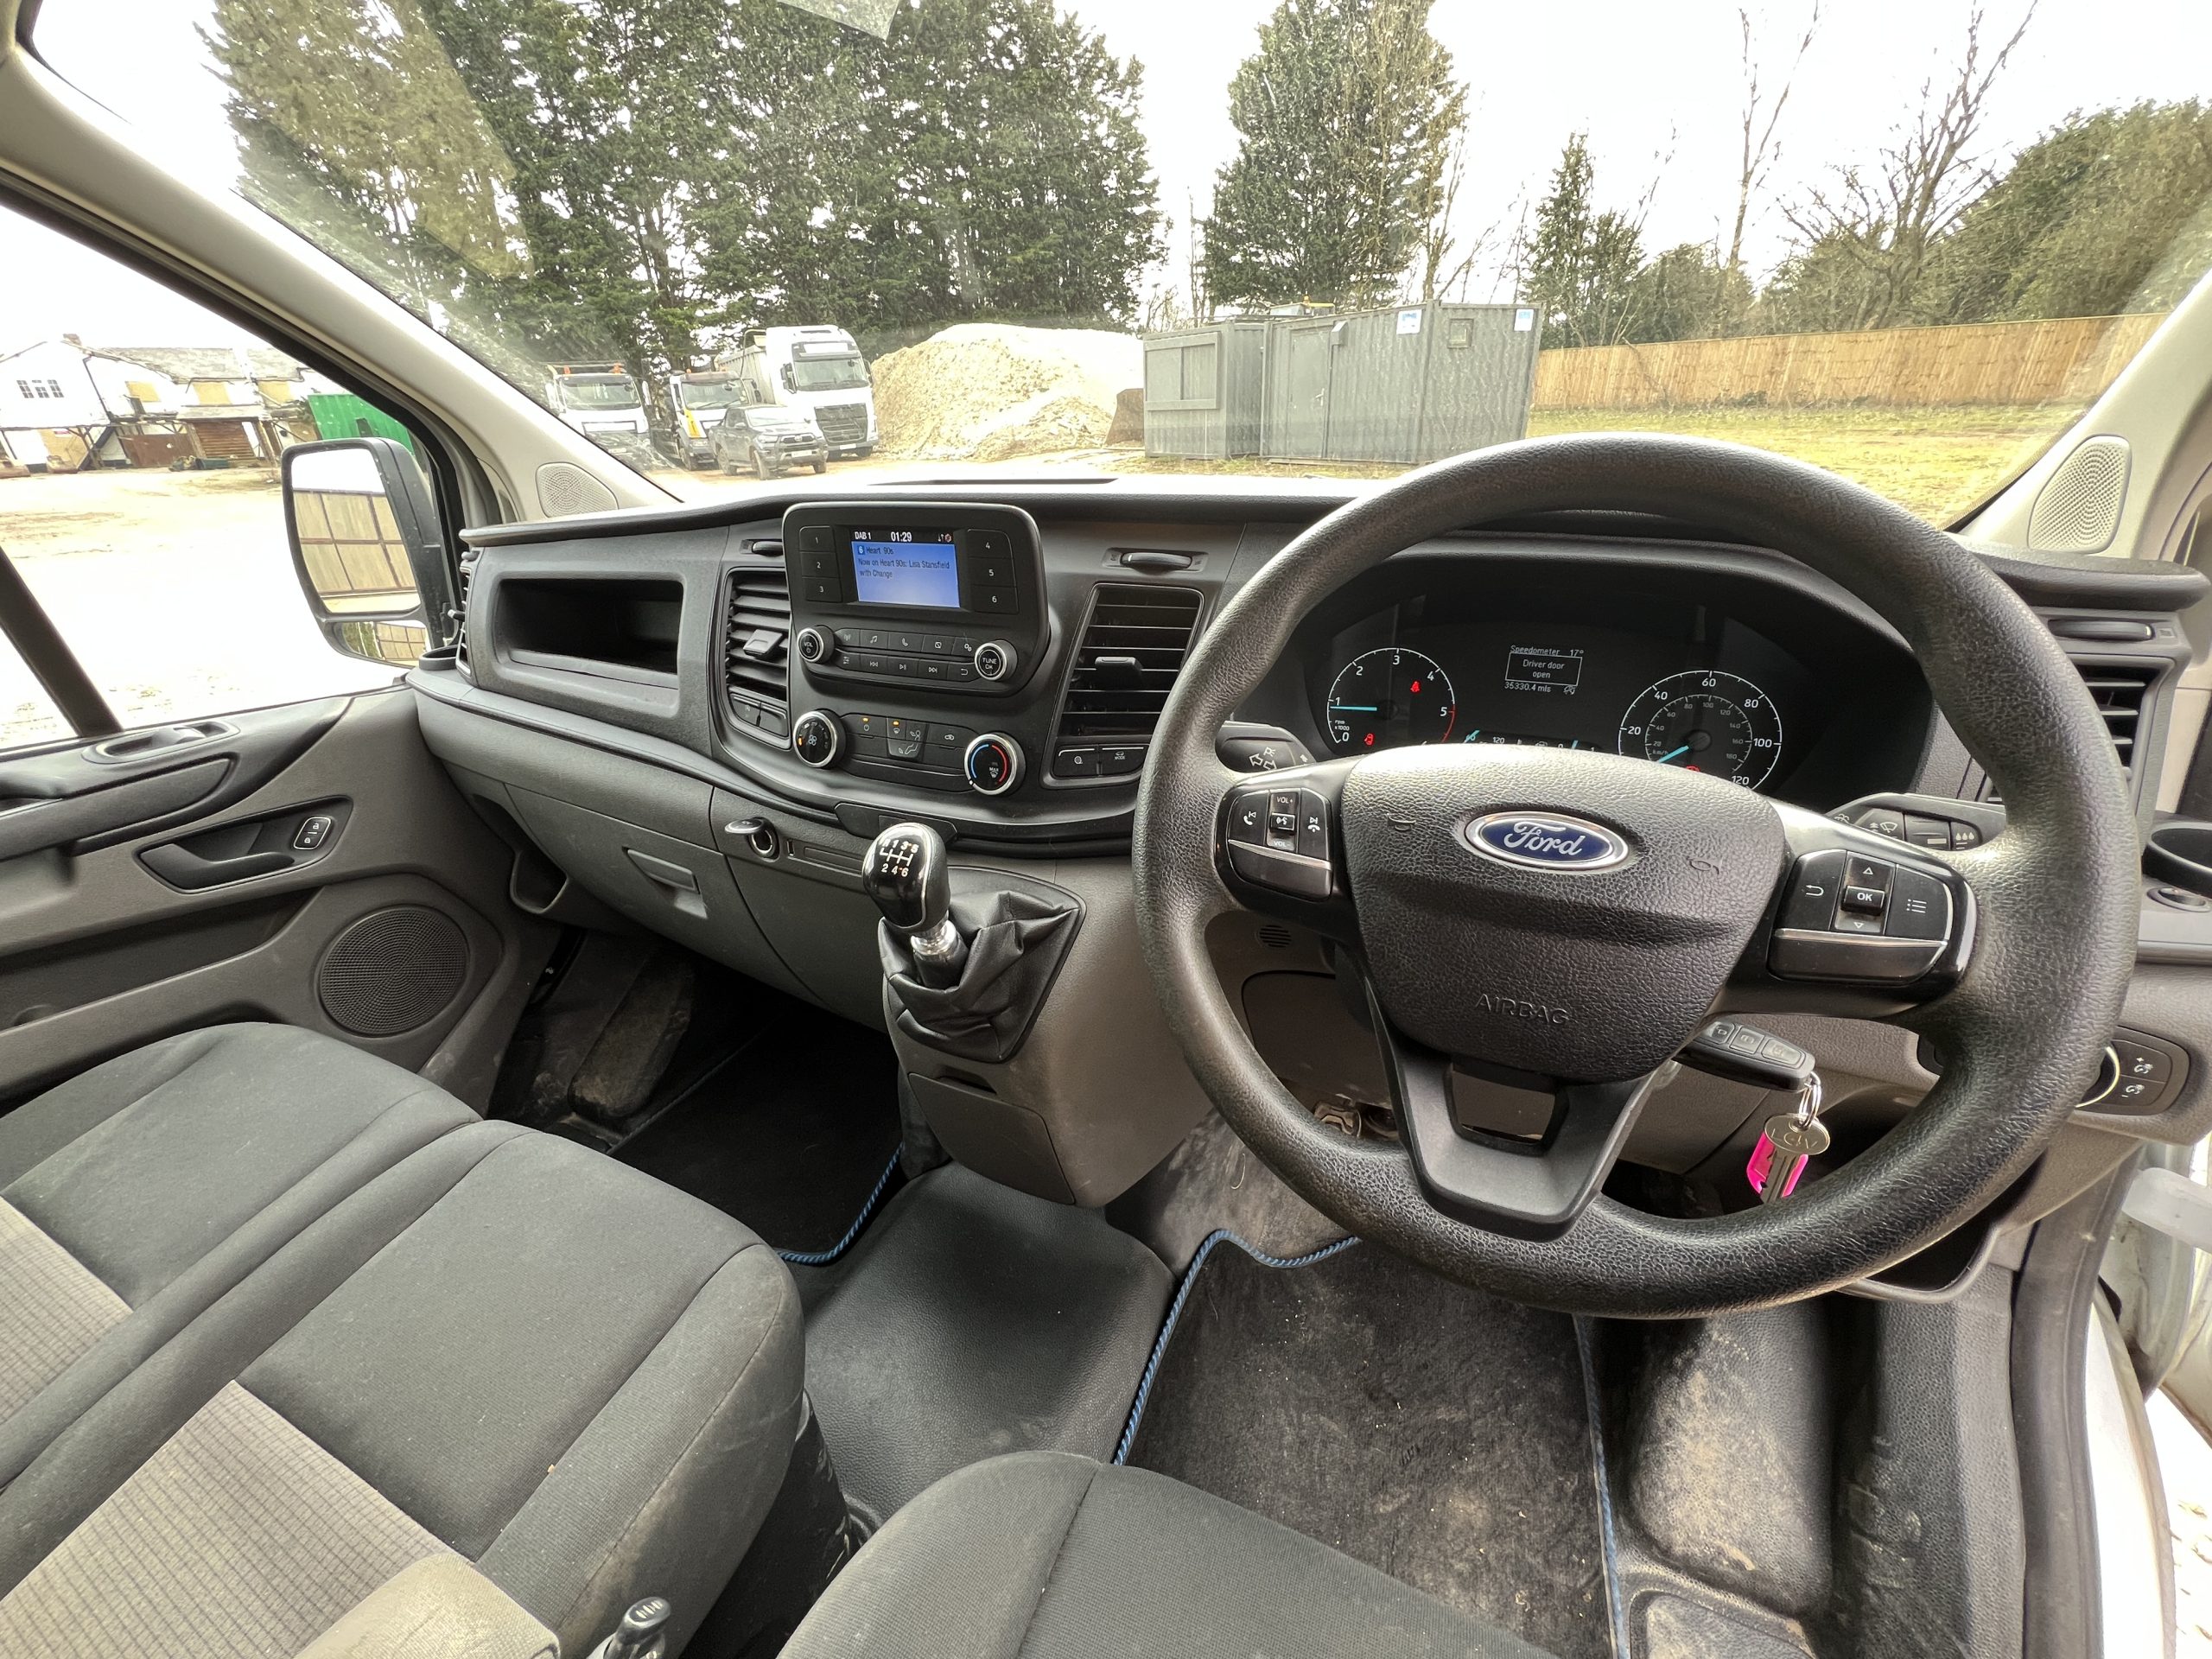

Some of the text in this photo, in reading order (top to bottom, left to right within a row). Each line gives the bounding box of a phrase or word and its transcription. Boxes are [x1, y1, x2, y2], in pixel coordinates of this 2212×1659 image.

[855, 531, 872, 540] DAB 1
[890, 531, 912, 542] 01:29
[922, 561, 950, 569] Stansfield
[873, 570, 893, 579] Change
[1510, 645, 1560, 656] Speedometer
[1392, 655, 1400, 664] 3
[1522, 659, 1565, 670] Driver door
[1356, 666, 1363, 676] 2
[1427, 671, 1434, 681] 4
[1504, 682, 1535, 691] 35330.4
[1701, 678, 1716, 687] 60
[1654, 691, 1668, 701] 40
[1335, 696, 1340, 706] 1
[1744, 699, 1758, 708] 80
[1440, 707, 1447, 716] 5
[1627, 726, 1642, 735] 20
[1342, 732, 1350, 741] 0
[1753, 738, 1772, 748] 100
[1731, 775, 1750, 785] 120
[1503, 821, 1586, 855] Ford
[900, 841, 909, 850] 3
[911, 844, 919, 853] 5
[881, 863, 889, 873] 2
[891, 866, 898, 874] 4
[901, 867, 909, 877] 6
[1857, 893, 1873, 901] OK
[1474, 993, 1570, 1024] AIRBAG
